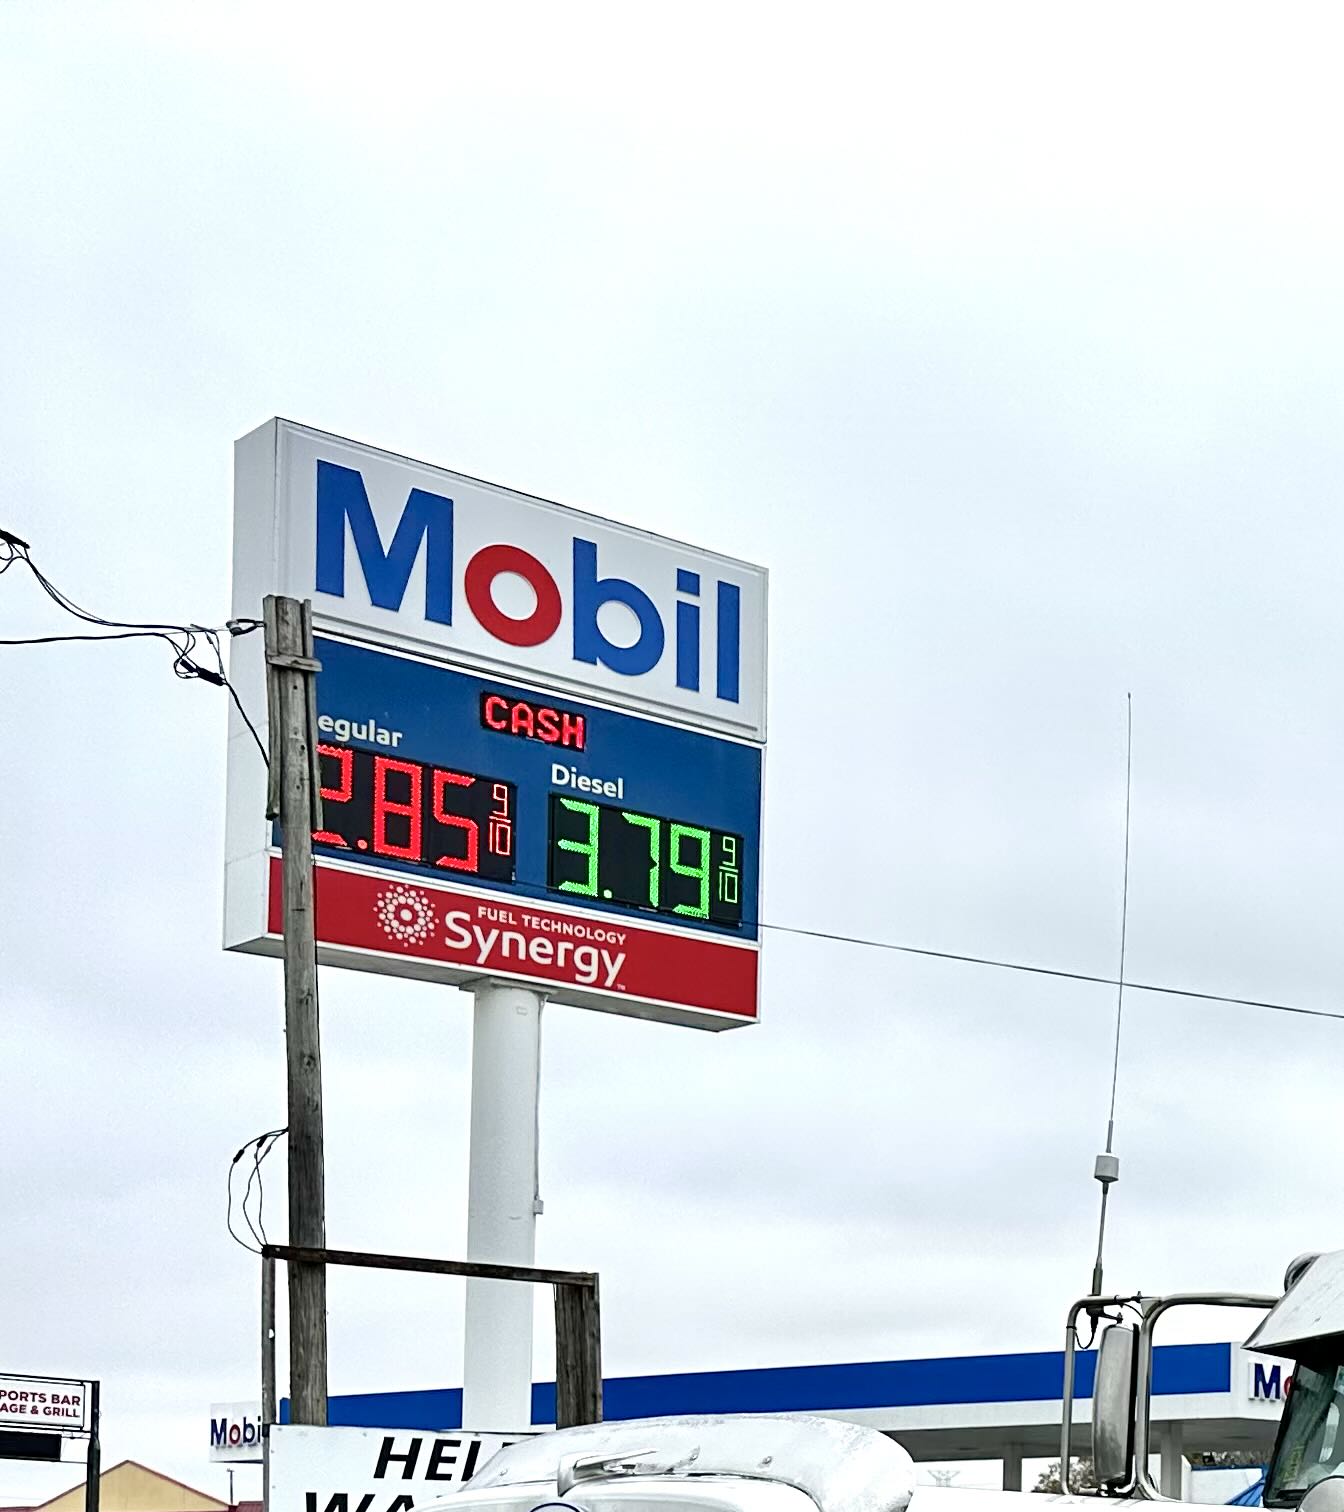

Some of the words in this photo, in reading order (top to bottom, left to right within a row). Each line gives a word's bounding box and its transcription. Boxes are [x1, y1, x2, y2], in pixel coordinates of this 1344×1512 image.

[315, 458, 740, 704] Mobil
[317, 714, 403, 748] egular
[485, 696, 585, 749] CASH
[551, 762, 624, 800] Diesel
[311, 743, 479, 873] 2.85
[557, 797, 712, 920] 3.79
[478, 905, 518, 927] FUEL
[521, 913, 627, 946] TECHNOLOGY
[444, 910, 627, 988] Synergy
[30, 1405, 39, 1415] &
[43, 1406, 81, 1418] GRILL
[51, 1393, 81, 1406] BAR
[210, 1415, 261, 1447] Mobi
